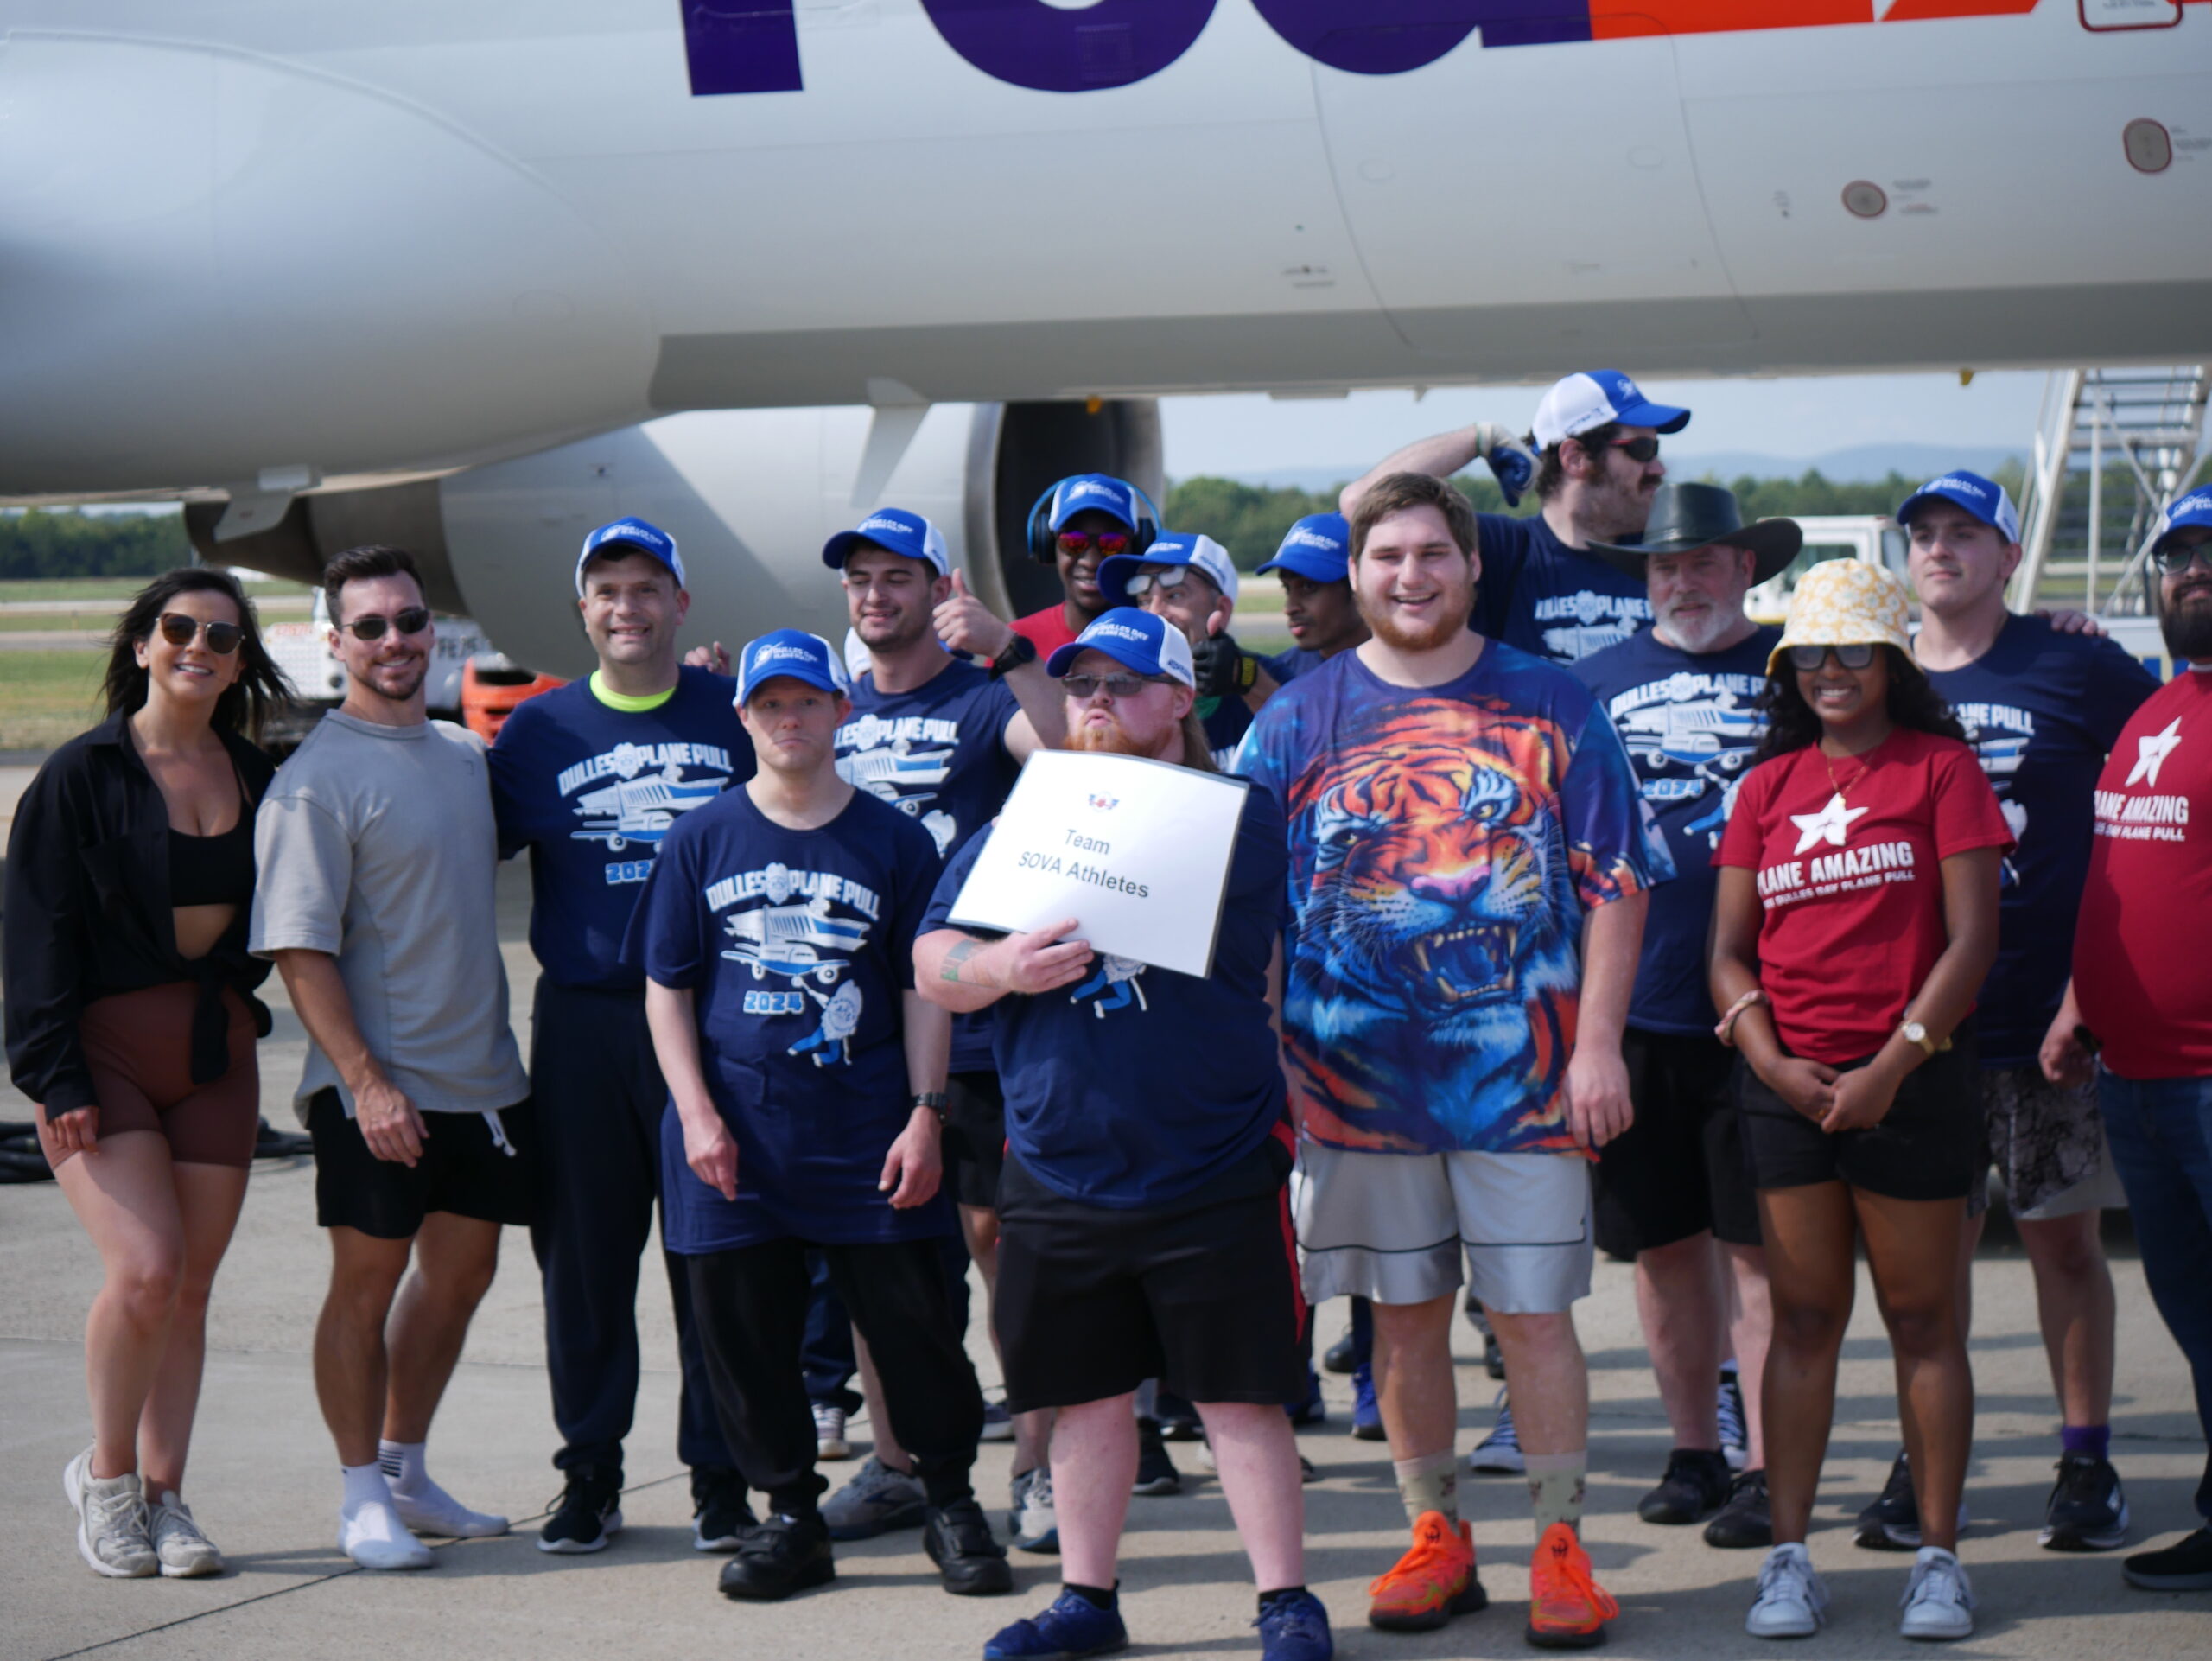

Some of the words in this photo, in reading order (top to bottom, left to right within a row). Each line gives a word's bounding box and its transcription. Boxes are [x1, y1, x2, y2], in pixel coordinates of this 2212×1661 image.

[1596, 595, 1644, 619] PLANE
[1610, 678, 1671, 721] DULLES
[1691, 673, 1750, 696] PLANE
[876, 716, 923, 741] PLANE
[923, 718, 960, 745] PULL
[1990, 703, 2036, 736] PULL
[557, 751, 615, 797] DULLES
[637, 742, 691, 767] PLANE
[691, 742, 734, 773] PULL
[2120, 795, 2189, 825] AMAZING
[1065, 829, 1111, 855] Team
[2121, 825, 2152, 841] PLANE
[2152, 826, 2185, 842] PULL
[605, 859, 655, 885] 202
[1018, 851, 1061, 874] SOVA
[1065, 862, 1149, 898] Athletes
[1810, 841, 1914, 883] AMAZING
[1840, 875, 1882, 891] PLANE
[1884, 869, 1916, 883] PULL
[705, 870, 766, 913] DULLES
[787, 869, 843, 900] PLANE
[842, 879, 880, 921] PULL
[743, 990, 804, 1015] 2024
